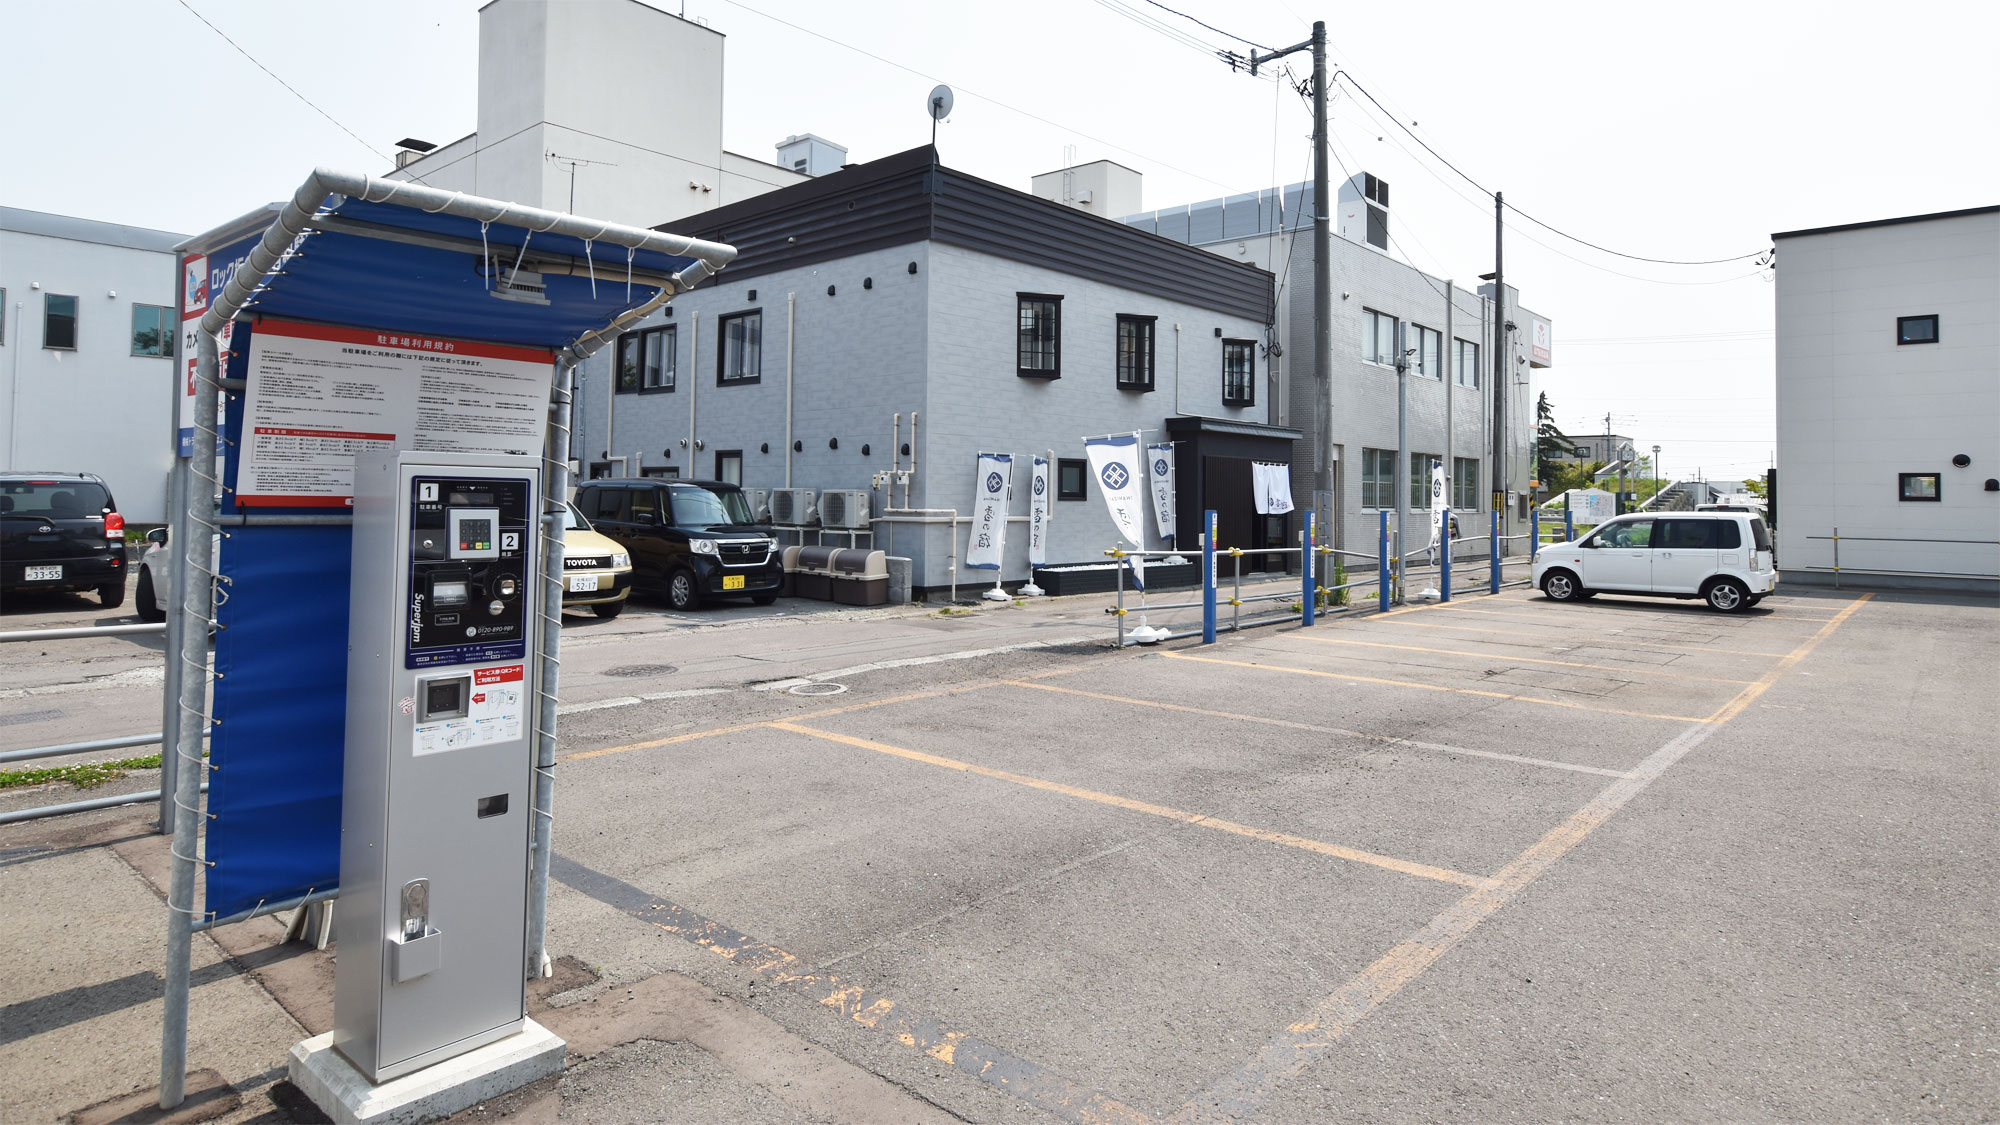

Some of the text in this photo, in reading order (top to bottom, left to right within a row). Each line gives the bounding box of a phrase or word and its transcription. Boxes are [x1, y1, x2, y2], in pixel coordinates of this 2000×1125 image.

[377, 335, 454, 352] 駐車場利用規約
[425, 486, 432, 498] 1
[506, 535, 514, 547] 2
[566, 559, 597, 567] TOYOTA
